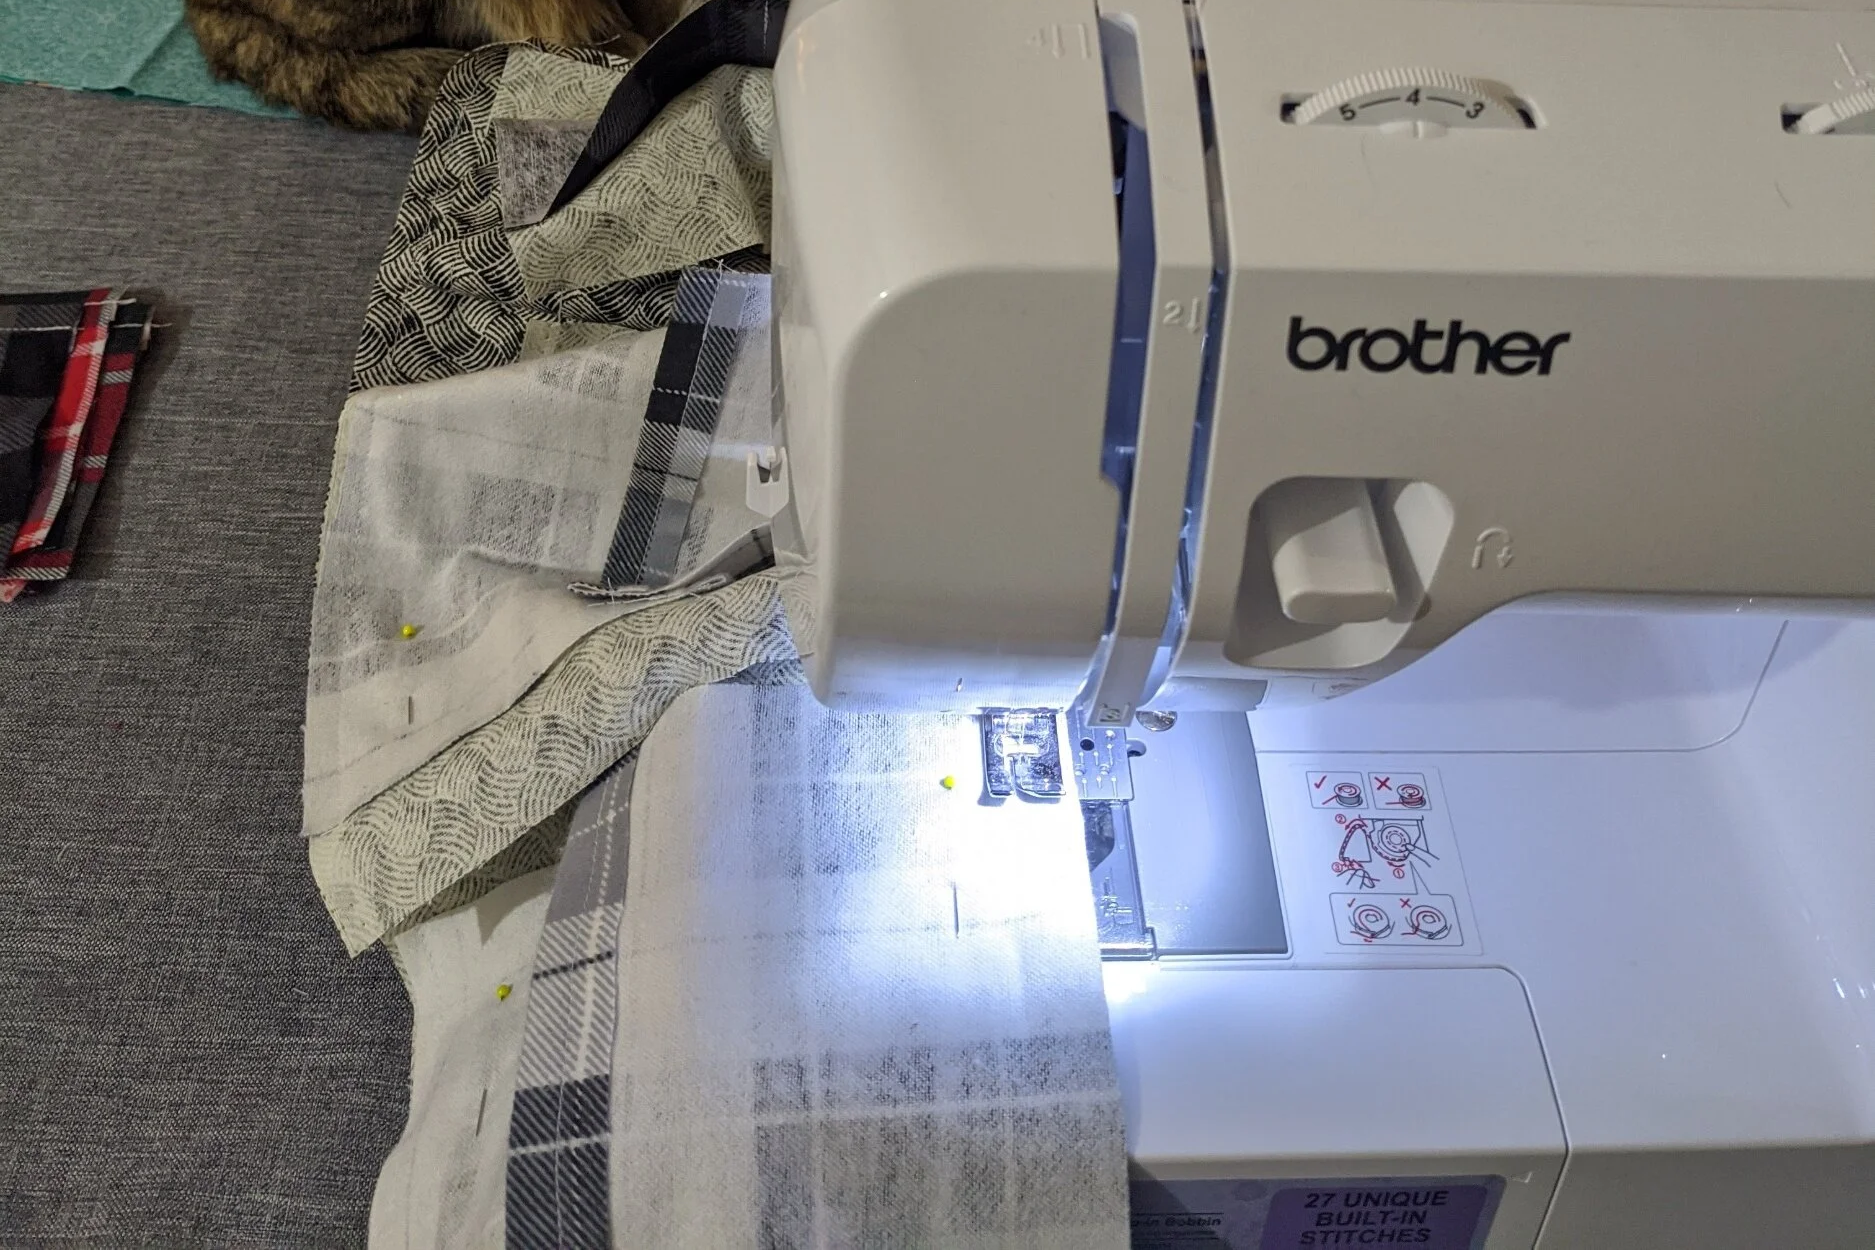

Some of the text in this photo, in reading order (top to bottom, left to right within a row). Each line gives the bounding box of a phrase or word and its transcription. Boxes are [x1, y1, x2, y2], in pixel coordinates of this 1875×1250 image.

[1339, 88, 1485, 121] 5 4 3
[1287, 316, 1571, 376] brother
[1304, 1190, 1449, 1208] 27 UNIQUE
[1316, 1210, 1427, 1227] BUILT-IN
[1300, 1228, 1432, 1245] STITCHES
